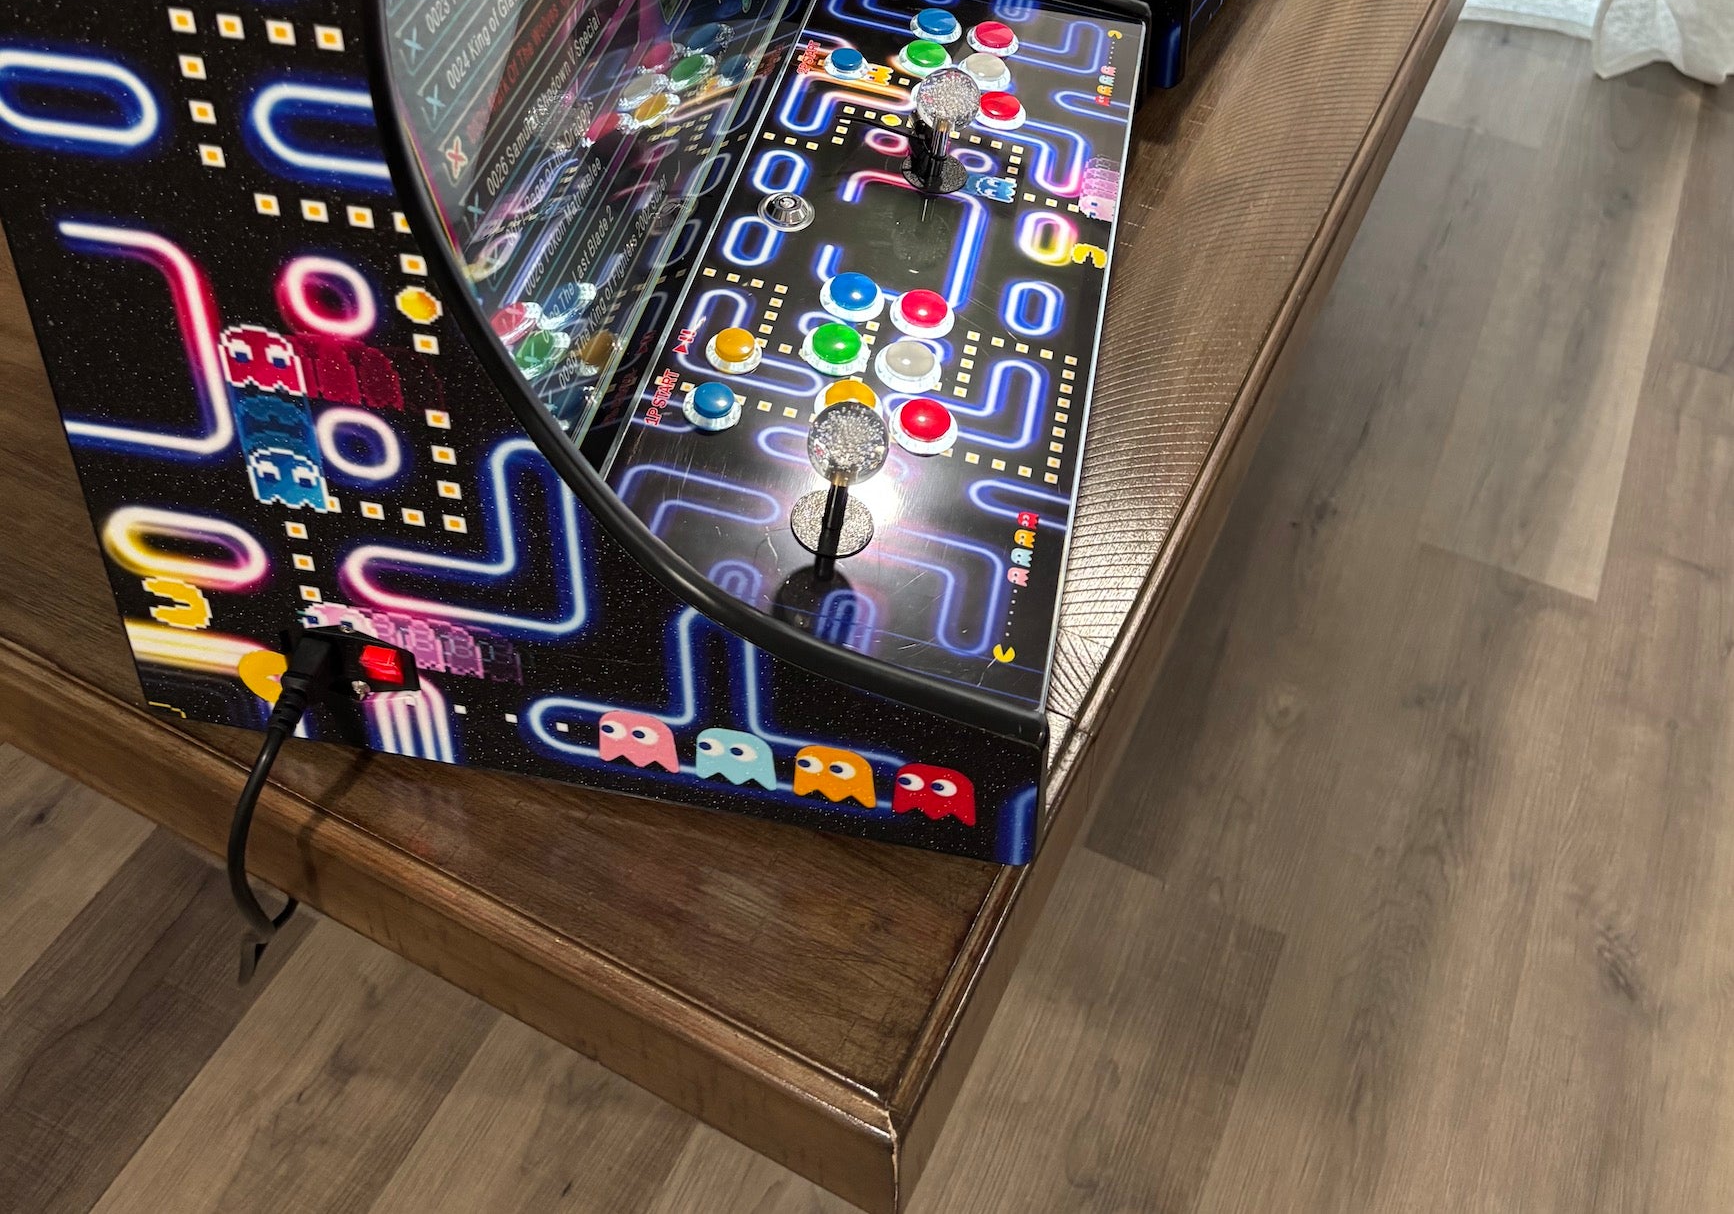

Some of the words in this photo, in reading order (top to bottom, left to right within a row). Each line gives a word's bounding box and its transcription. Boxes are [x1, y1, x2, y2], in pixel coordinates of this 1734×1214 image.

[446, 48, 471, 90] 0024
[467, 26, 491, 61] King
[488, 5, 502, 33] of
[506, 61, 520, 84] Of
[515, 42, 534, 67] The
[531, 5, 559, 47] Wolves
[485, 156, 509, 197] 0026
[506, 108, 538, 165] Samurai
[537, 59, 571, 116] Shodown
[574, 12, 602, 56] Special
[523, 181, 544, 214] Rage
[544, 165, 554, 186] of
[563, 100, 595, 147] Dragons
[524, 259, 545, 297] 0028
[543, 221, 567, 261] Tokon
[564, 156, 602, 226] Matrimelee
[558, 282, 575, 311] The
[572, 250, 589, 285] Last
[587, 219, 609, 257] Blade
[605, 204, 614, 225] 2
[558, 354, 578, 390] 0030
[575, 333, 592, 358] The
[587, 297, 608, 335] King
[606, 281, 615, 301] of
[613, 238, 639, 288] Fighters
[635, 208, 656, 240] 2002
[649, 175, 667, 218] Super
[644, 406, 663, 427] 1P
[653, 368, 680, 409] START
